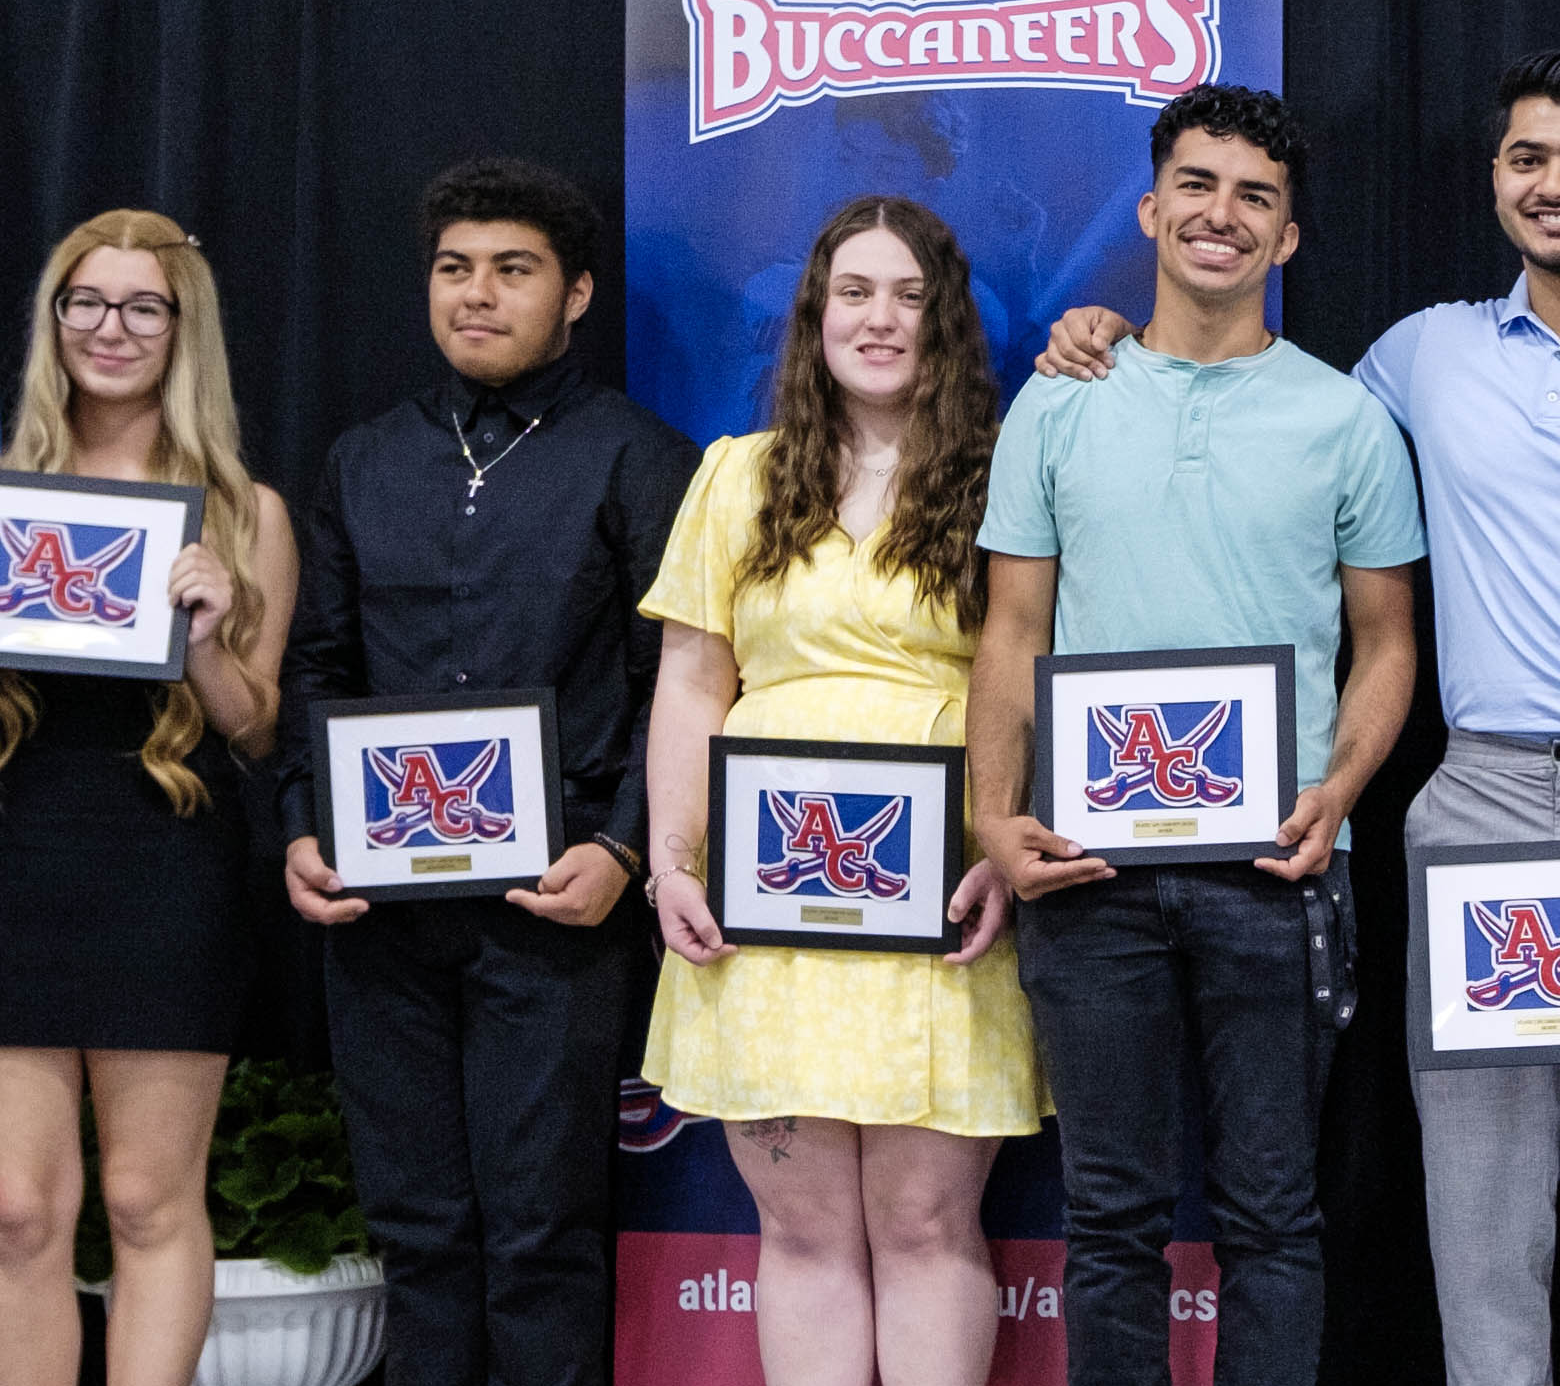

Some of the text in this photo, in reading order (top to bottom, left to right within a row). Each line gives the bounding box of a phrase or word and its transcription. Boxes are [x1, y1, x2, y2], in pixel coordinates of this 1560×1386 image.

[18, 531, 95, 613] AC
[396, 755, 472, 836] AC
[1118, 712, 1196, 799] AC
[791, 801, 867, 890] AC
